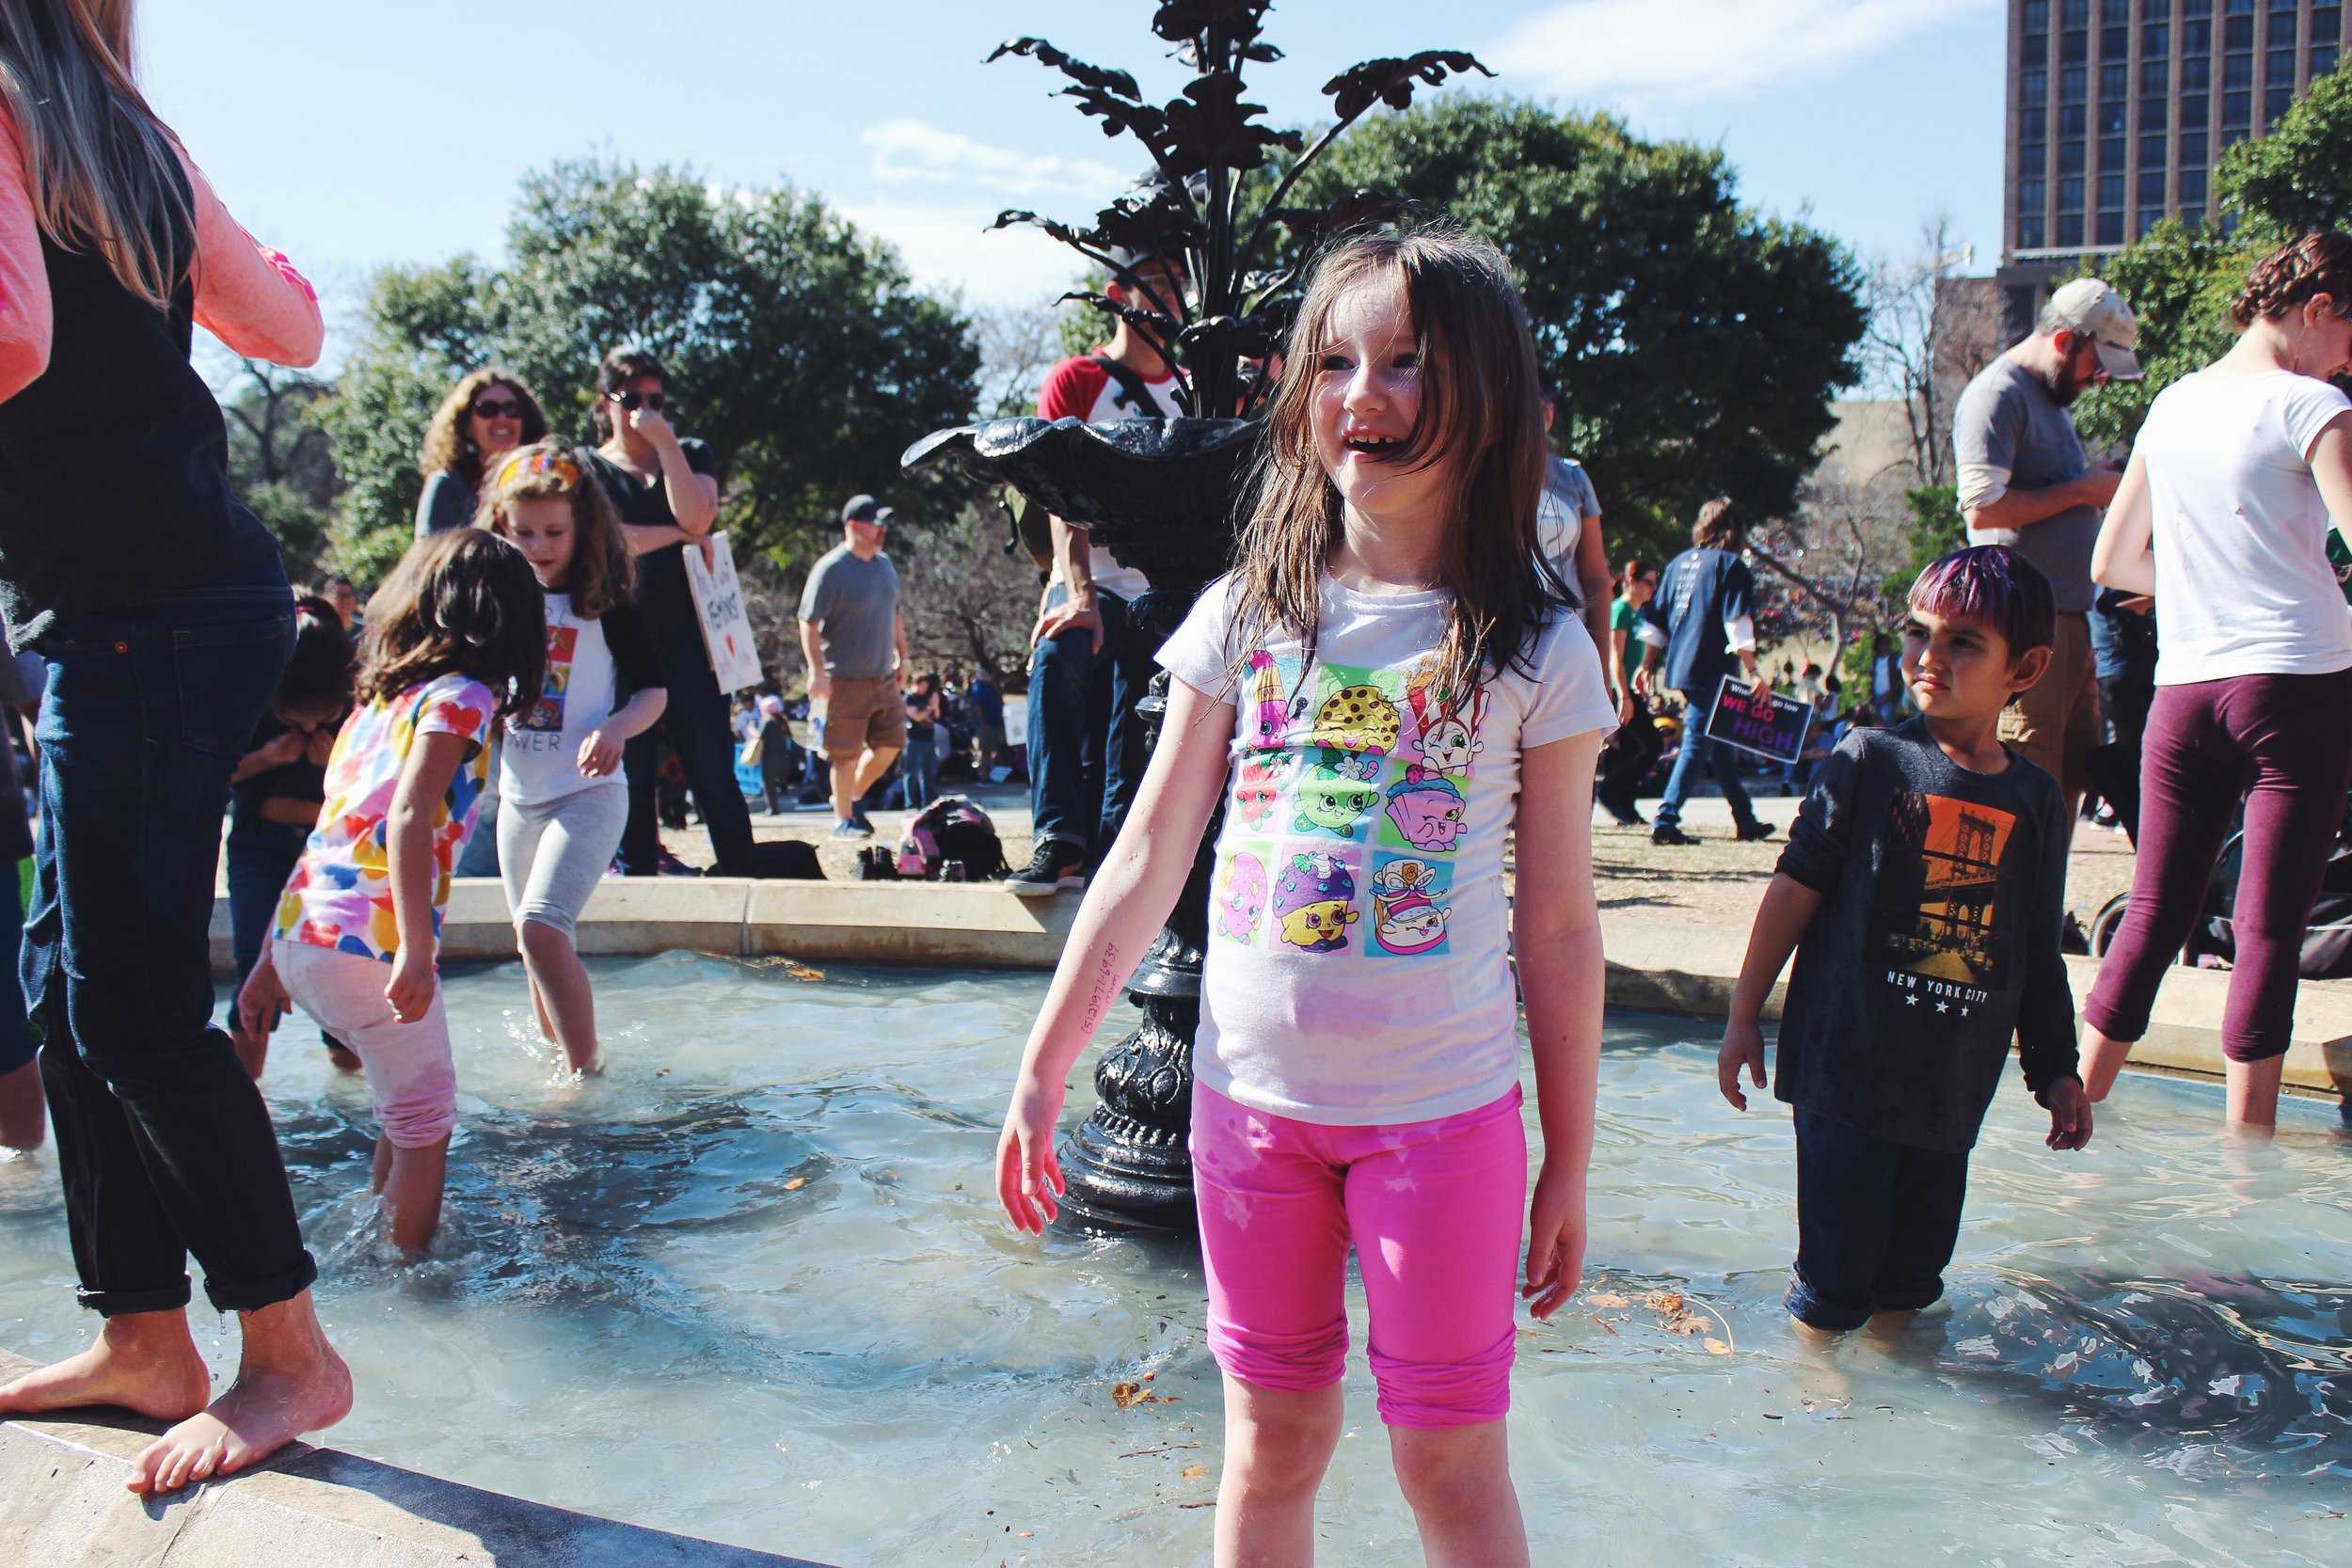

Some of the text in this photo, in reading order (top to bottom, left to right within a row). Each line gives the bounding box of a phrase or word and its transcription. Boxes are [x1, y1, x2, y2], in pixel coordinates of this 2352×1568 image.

[1723, 694, 1776, 722] WE GO
[1887, 970, 1988, 1004] NEW YORK CITY
